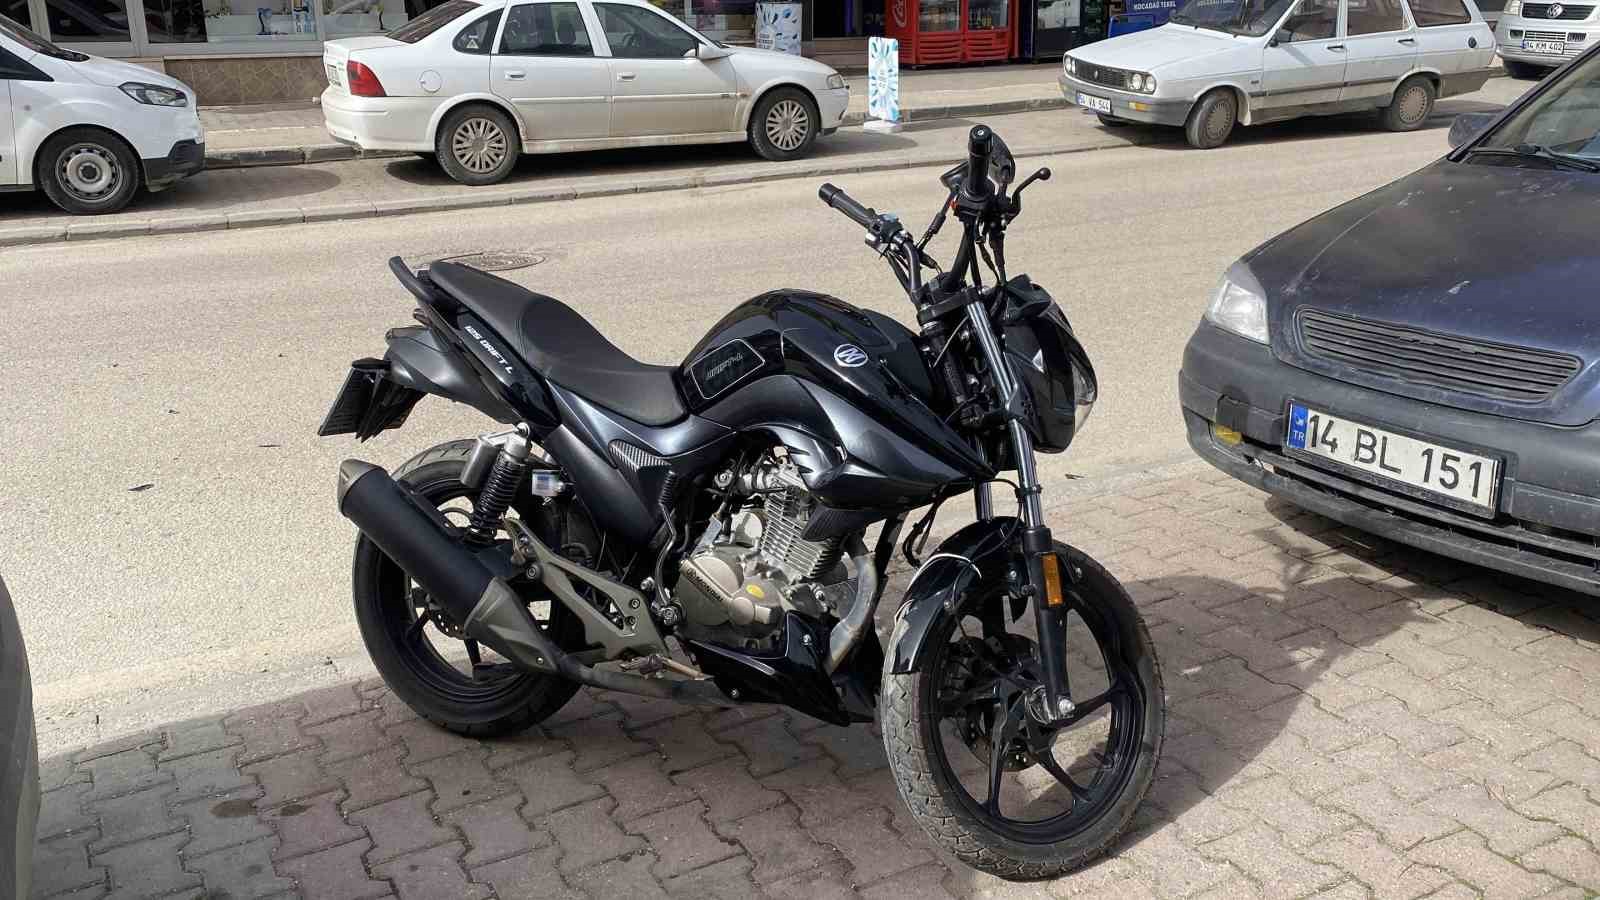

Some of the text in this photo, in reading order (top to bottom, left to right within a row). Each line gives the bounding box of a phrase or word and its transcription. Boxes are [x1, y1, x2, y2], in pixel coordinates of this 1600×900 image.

[480, 339, 508, 364] DRIFT
[1292, 430, 1305, 442] TR
[1309, 414, 1483, 498] 14 BL 151
